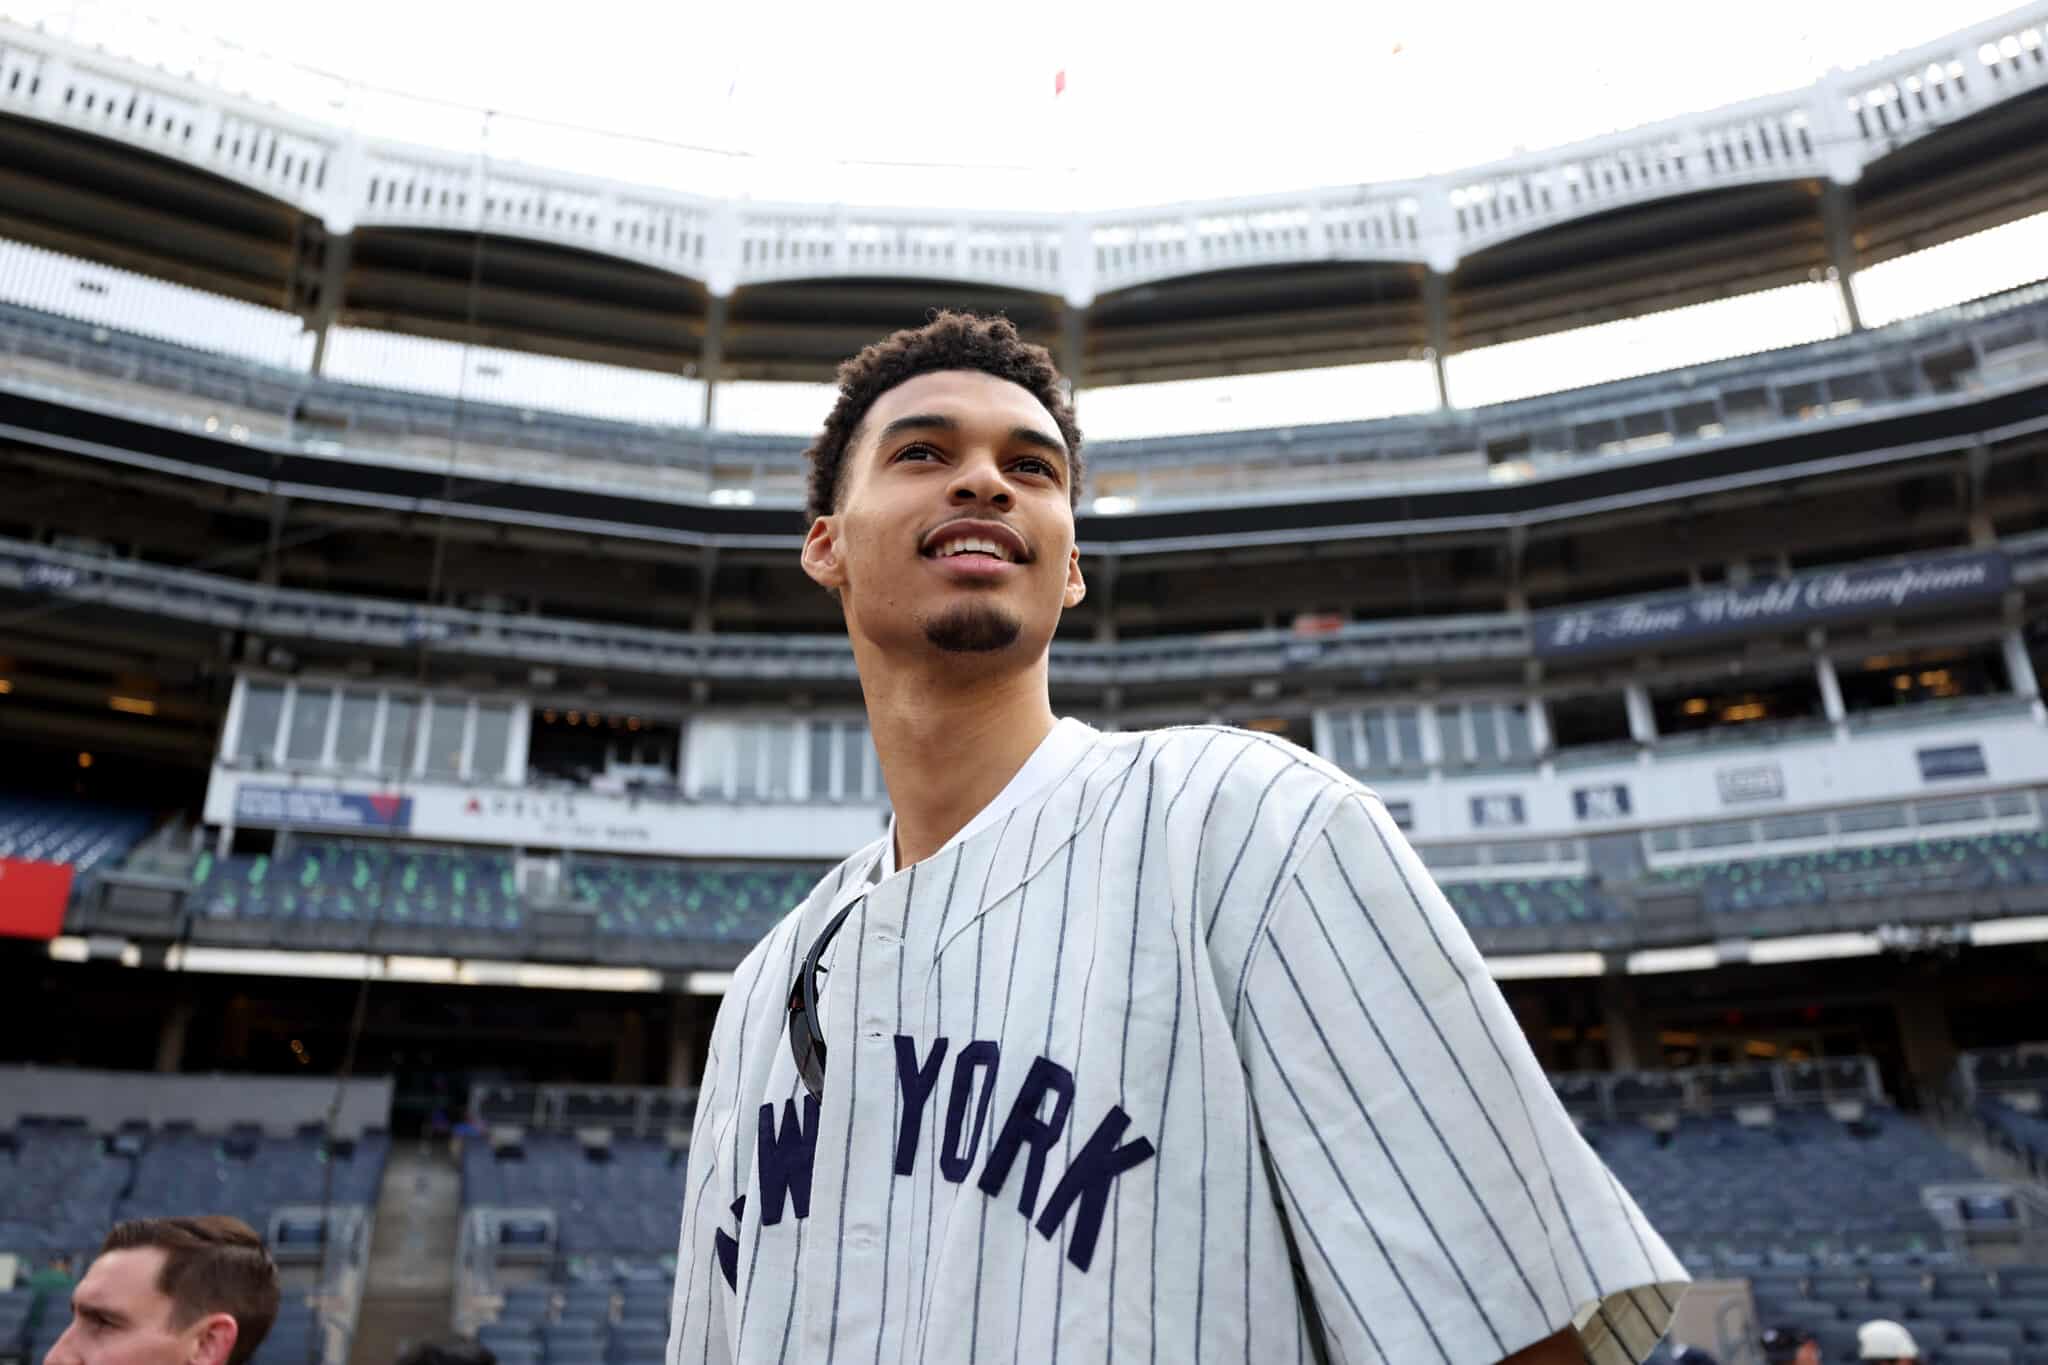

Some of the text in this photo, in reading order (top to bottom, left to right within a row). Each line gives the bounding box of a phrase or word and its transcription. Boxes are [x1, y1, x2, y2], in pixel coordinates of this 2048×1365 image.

[1692, 578, 1800, 624] World
[1804, 563, 1987, 608] Champions
[894, 1035, 1155, 1273] YORK
